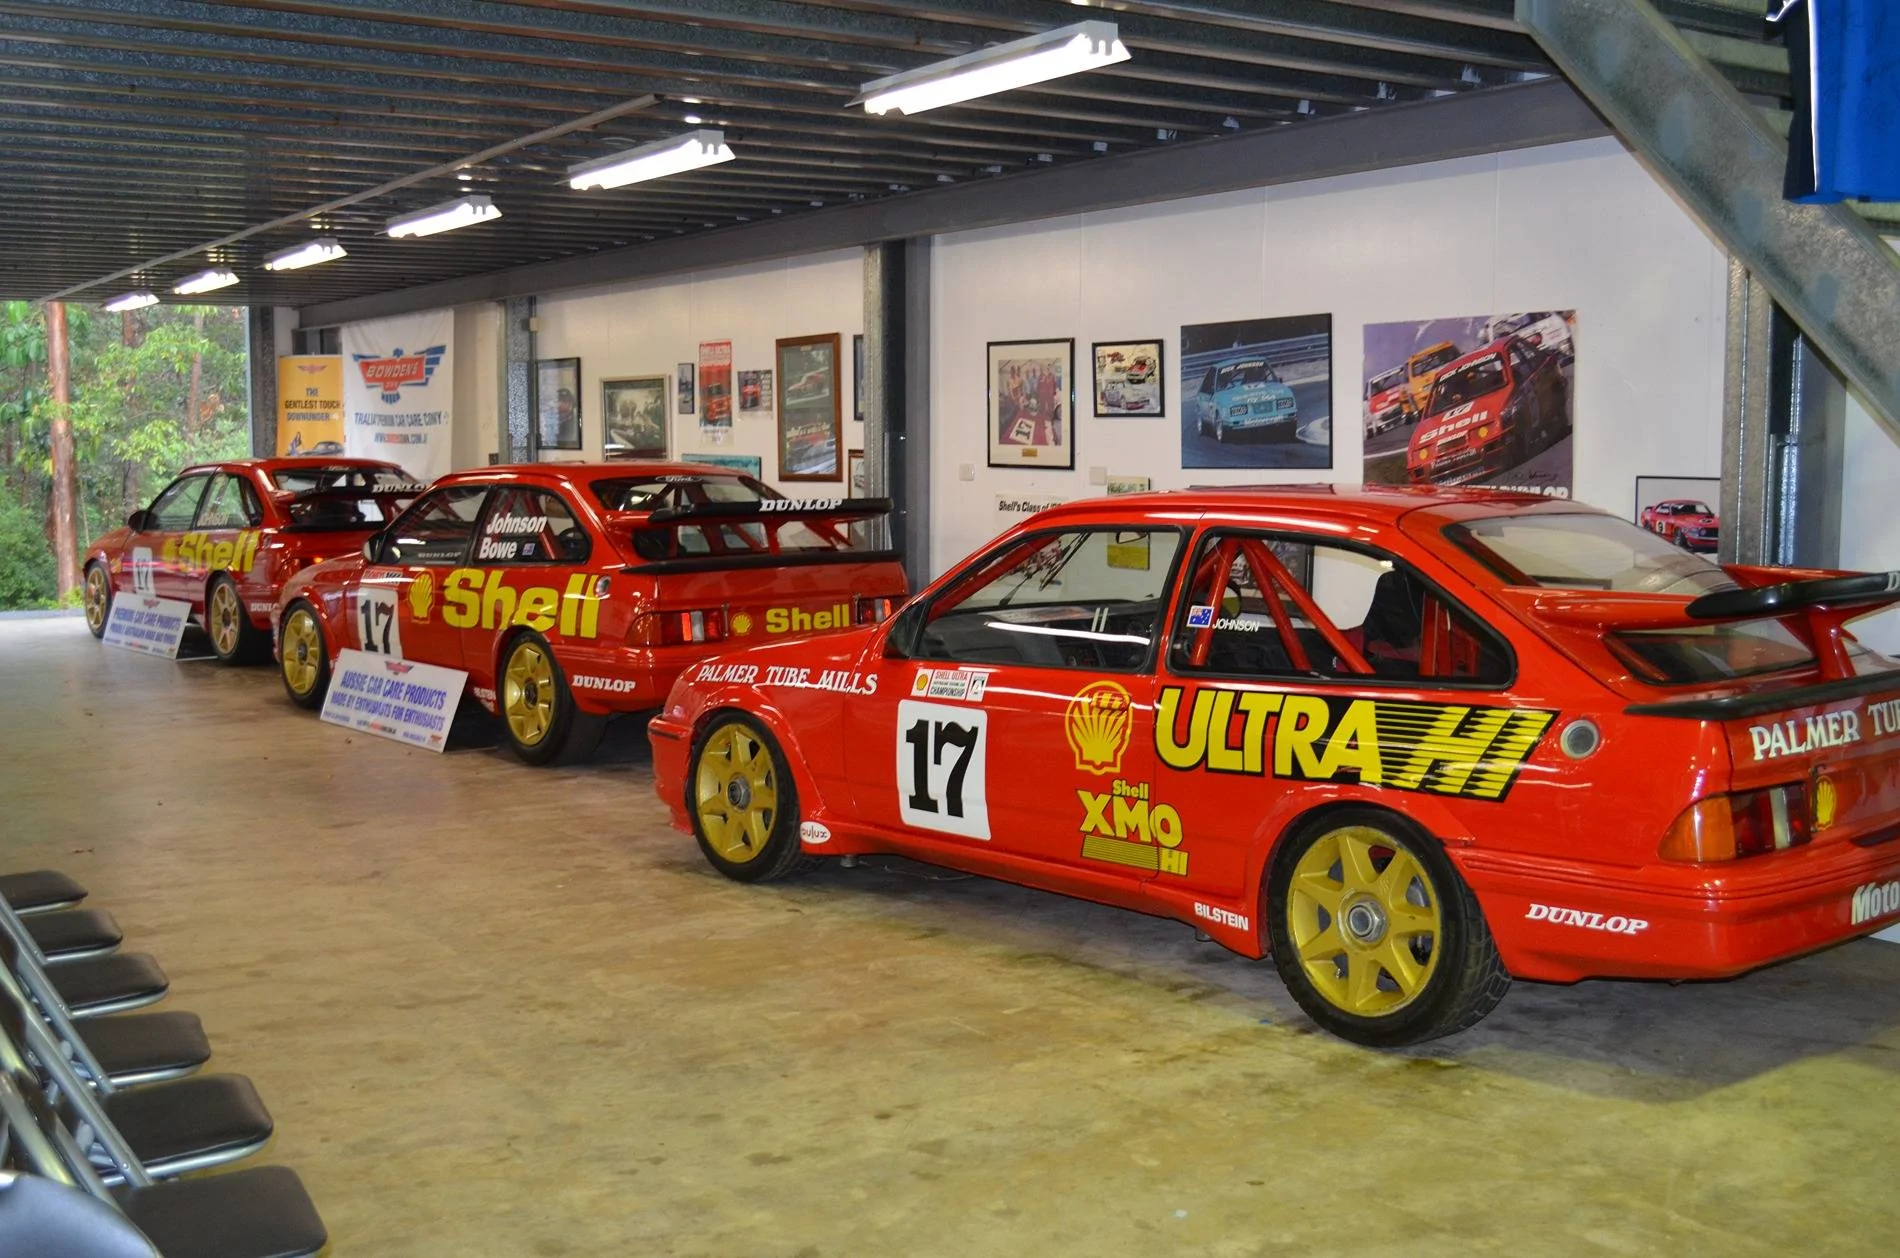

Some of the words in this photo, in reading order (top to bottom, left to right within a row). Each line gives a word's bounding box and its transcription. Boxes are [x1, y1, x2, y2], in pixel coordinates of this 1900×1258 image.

[1419, 411, 1488, 444] Shell
[759, 499, 843, 513] DUNLOP
[998, 501, 1020, 512] Shell's
[1022, 501, 1041, 513] Class
[486, 512, 547, 534] Johnson
[178, 530, 261, 573] Shell
[479, 537, 517, 560] Bowe
[442, 568, 601, 639] Shell
[766, 603, 850, 633] Shell
[361, 600, 394, 654] 17
[1212, 618, 1260, 632] JOHNSON
[342, 671, 368, 692] AUSSIE
[367, 675, 383, 695] CAR
[382, 679, 404, 701] CARE
[404, 685, 446, 710] PRODUCTS
[572, 674, 636, 692] DUNLOP
[696, 665, 759, 684] PALMER
[765, 666, 810, 686] TUBE
[817, 670, 878, 696] MILLS
[1154, 687, 1384, 786] ULTRA
[1749, 710, 1861, 760] PALMER
[906, 718, 979, 818] 17
[1112, 779, 1149, 800] Shell
[1077, 789, 1183, 849] XMO
[1194, 901, 1249, 931] BILSTEIN
[1525, 903, 1649, 935] DUNLOP
